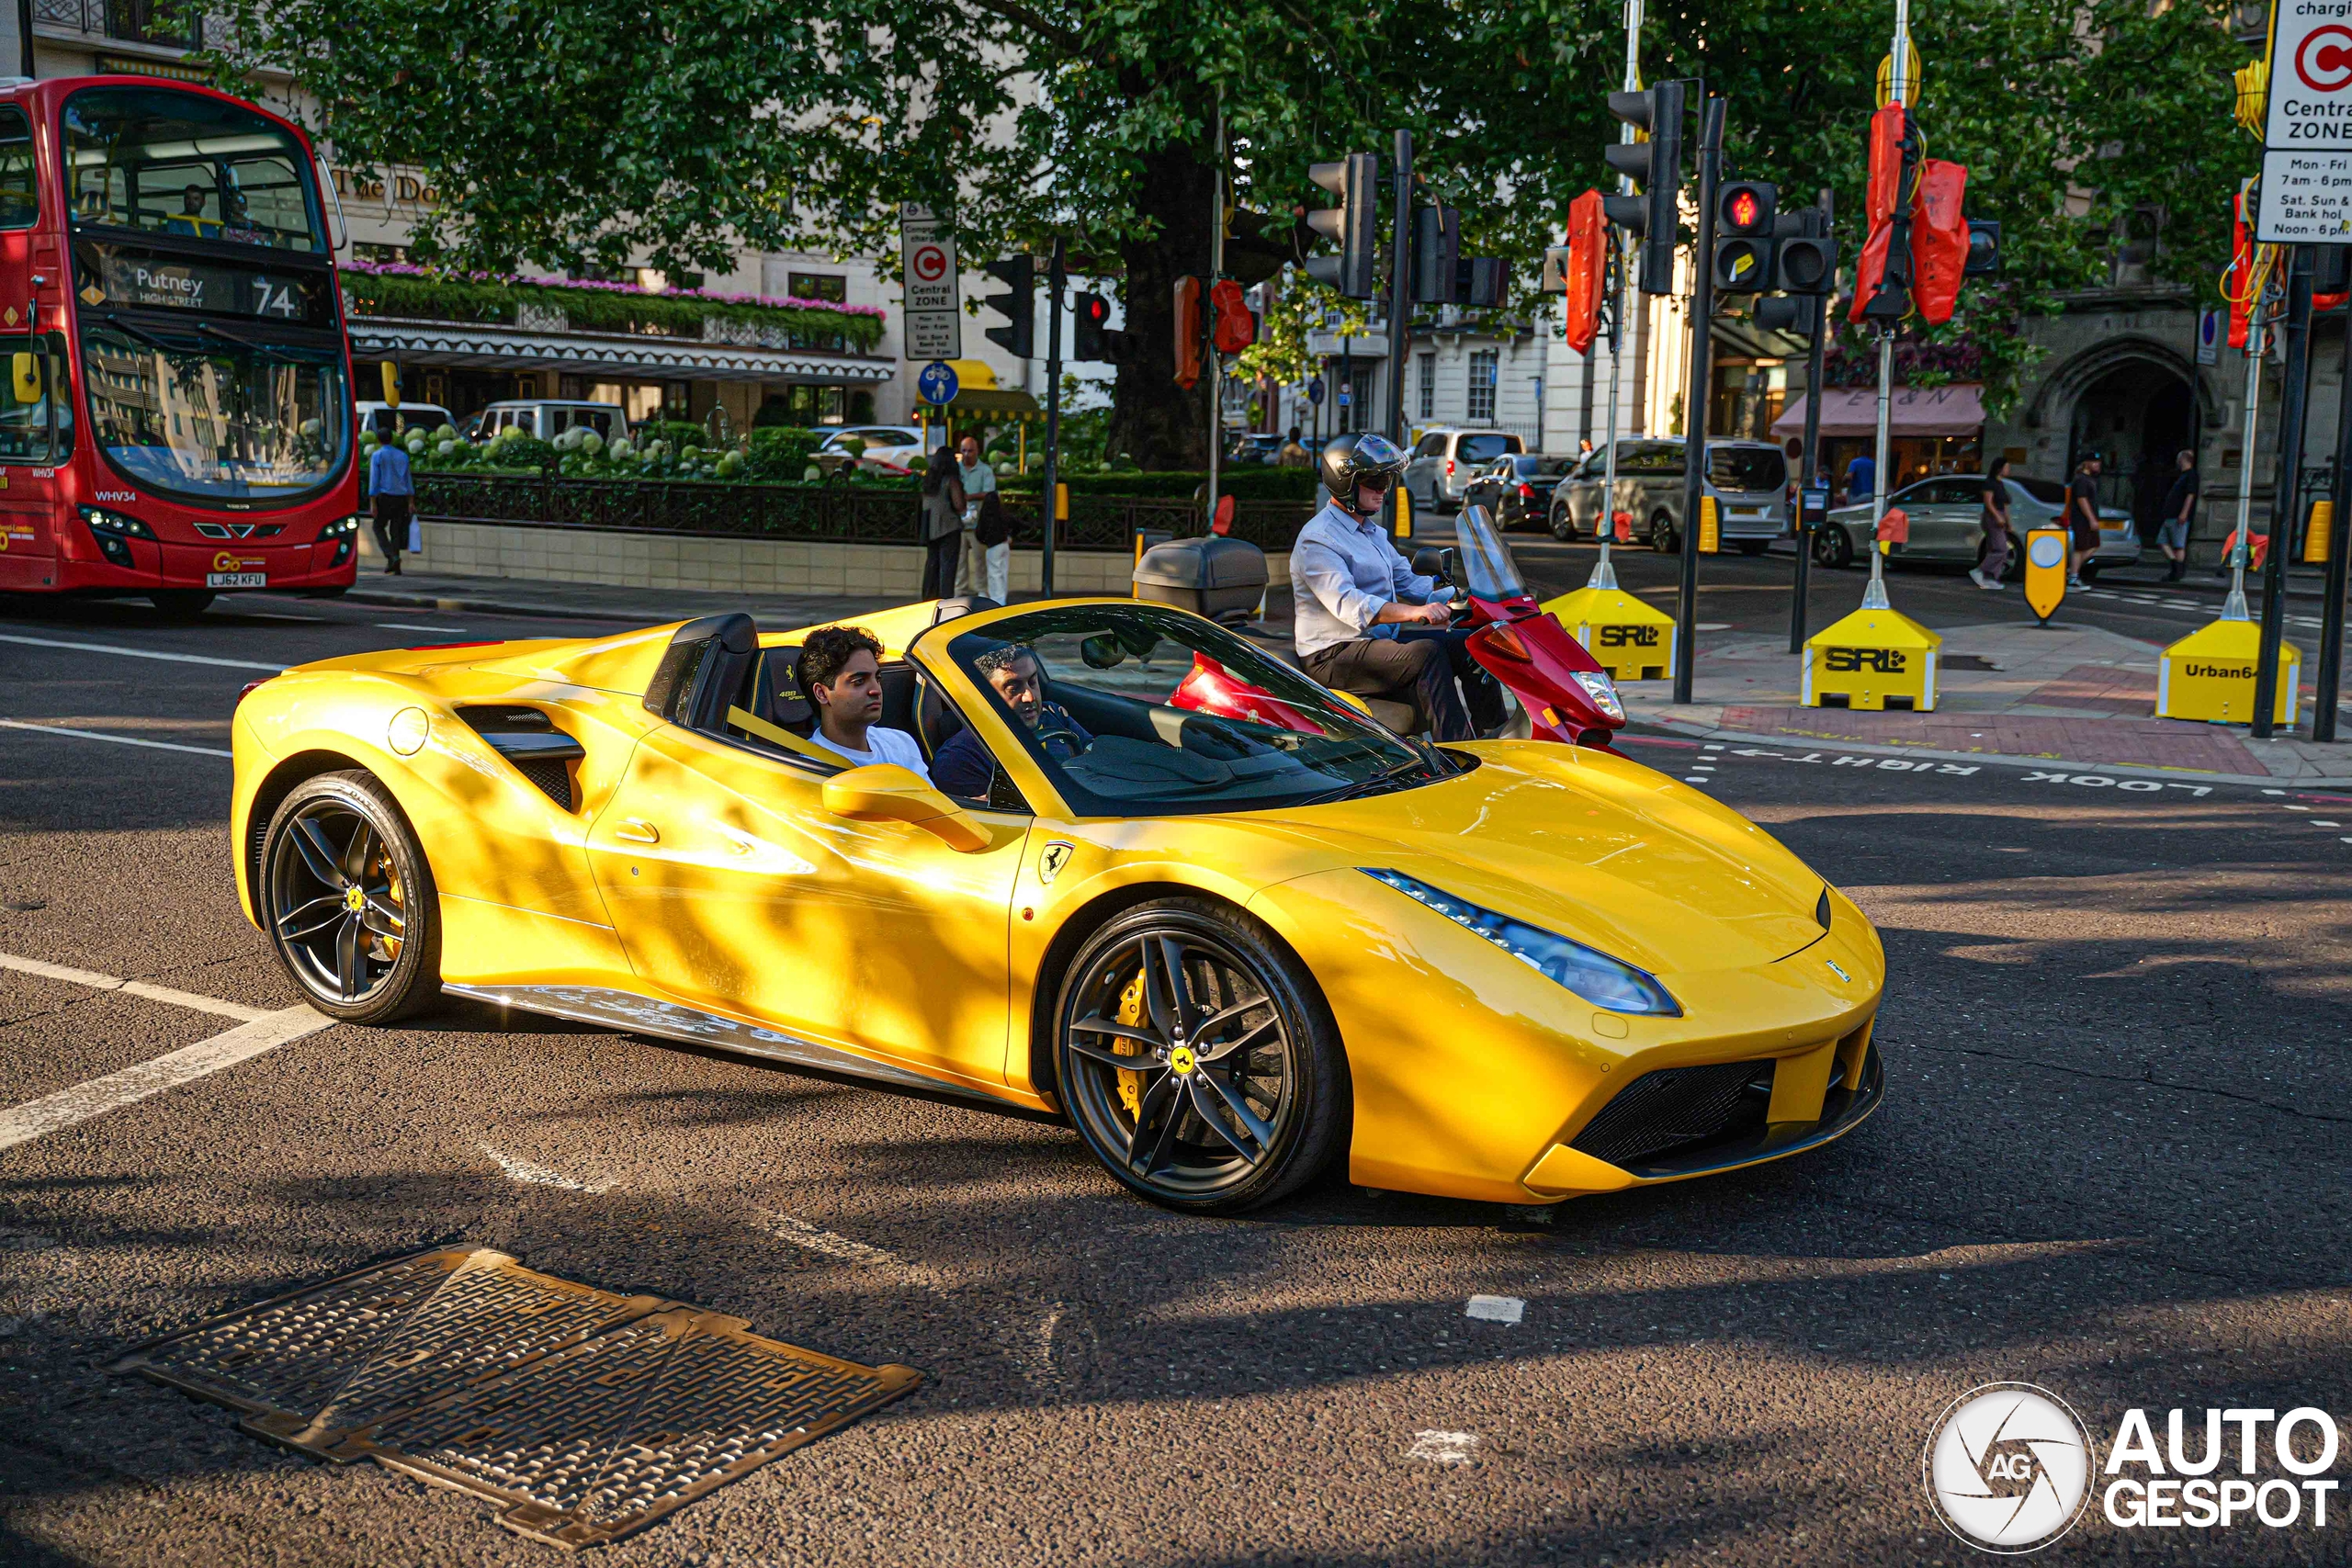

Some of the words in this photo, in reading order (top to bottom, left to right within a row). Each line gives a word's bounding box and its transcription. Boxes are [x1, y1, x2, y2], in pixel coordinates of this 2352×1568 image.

[2289, 122, 2352, 139] ZONE
[2290, 159, 2318, 169] Mon
[2330, 159, 2347, 170] Fri
[2311, 195, 2336, 206] Sun
[2341, 196, 2349, 206] &
[2285, 209, 2317, 219] Bank
[2322, 209, 2342, 220] hol
[2274, 223, 2308, 234] Noon
[137, 267, 203, 298] Putney
[911, 284, 951, 295] Central
[140, 292, 166, 304] HIGH
[167, 296, 202, 308] STREET
[253, 281, 295, 318] 74
[915, 296, 947, 307] ZONE
[32, 468, 55, 478] WHV34
[96, 491, 136, 502] WHV34
[211, 574, 239, 586] LJ62
[241, 574, 262, 586] KFU
[1600, 626, 1658, 647] SRL
[1826, 648, 1905, 673] SRL
[1781, 753, 1981, 776] RIGHT
[2020, 772, 2213, 797] LOOK
